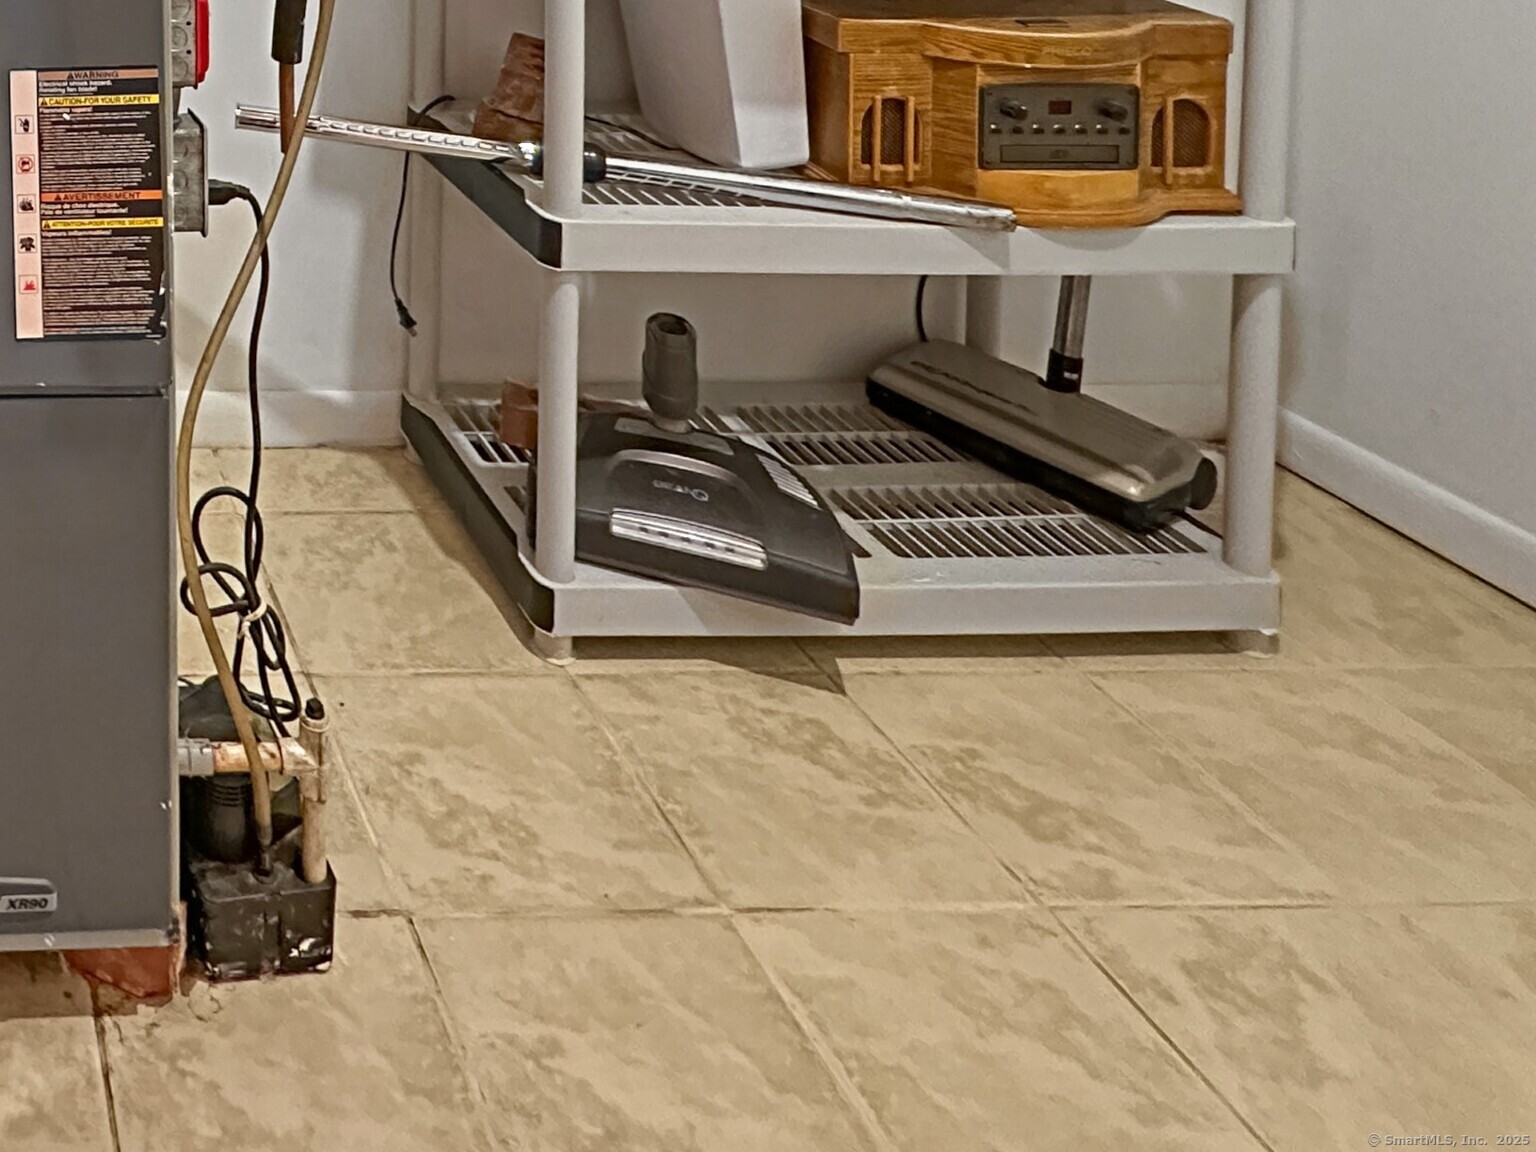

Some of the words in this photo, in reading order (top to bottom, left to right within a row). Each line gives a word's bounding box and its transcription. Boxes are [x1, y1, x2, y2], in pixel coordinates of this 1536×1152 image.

[74, 71, 119, 79] WARNING
[63, 192, 140, 201] AVERTISSEMENT
[5, 897, 49, 911] XR90
